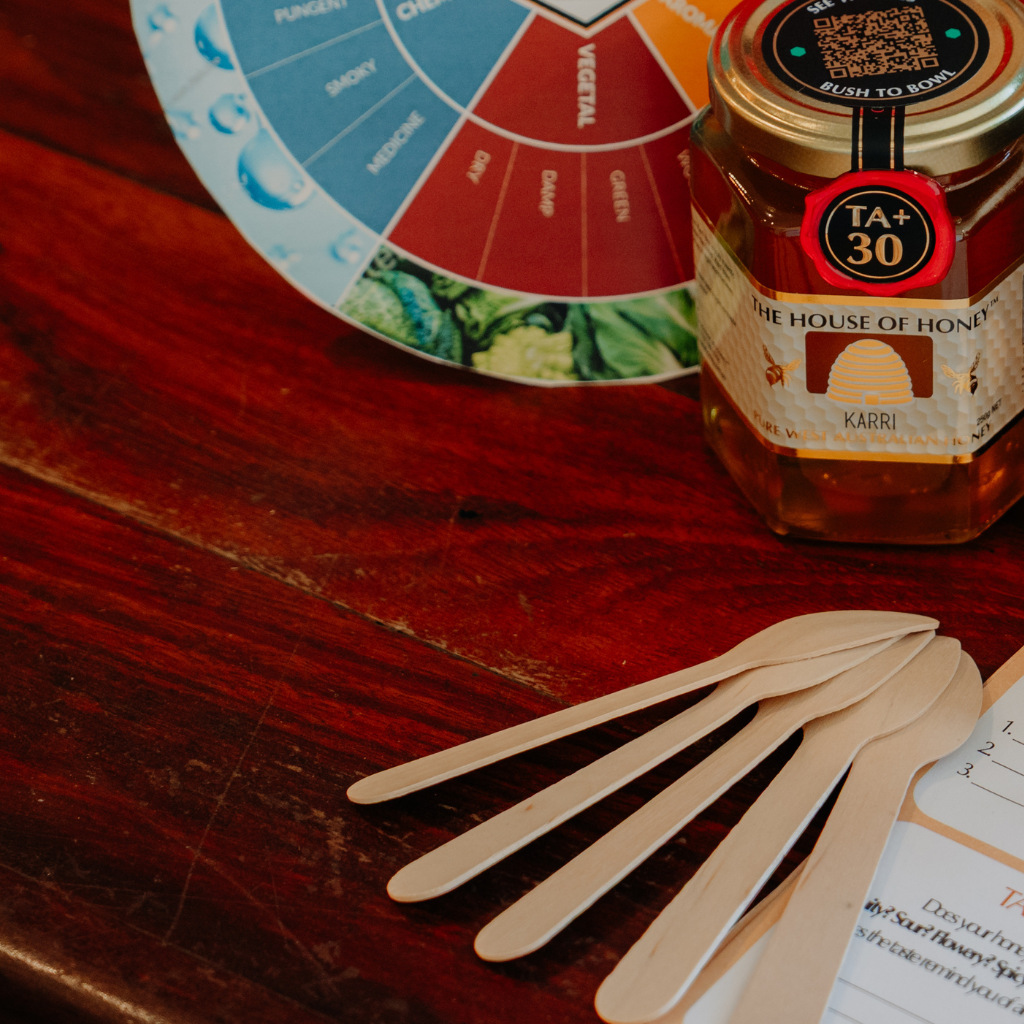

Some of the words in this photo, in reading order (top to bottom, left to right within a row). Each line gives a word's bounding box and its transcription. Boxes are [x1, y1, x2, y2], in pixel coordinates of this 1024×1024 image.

[325, 58, 377, 97] SMOKY
[577, 43, 597, 129] VEGETAL
[819, 80, 870, 98] BUSH
[875, 84, 903, 98] TO
[907, 67, 958, 96] BOWL
[366, 110, 426, 175] MEDICINE
[466, 149, 491, 185] DRY
[539, 170, 558, 218] DAMP
[610, 169, 631, 223] GREEN
[845, 204, 911, 230] TA+
[846, 232, 904, 268] 30
[751, 294, 783, 326] THE
[790, 313, 871, 331] HOUSE
[878, 315, 910, 332] OF
[785, 427, 827, 444] WEST
[833, 431, 939, 447] AUSTRALIAN
[943, 421, 993, 448] HONEY
[844, 411, 897, 431] KARRI
[1002, 720, 1014, 735] 1.
[956, 762, 974, 778] 3.
[922, 898, 961, 924] Does
[954, 916, 996, 939] your
[890, 910, 935, 938] Sour?
[931, 929, 997, 968] Flowery?
